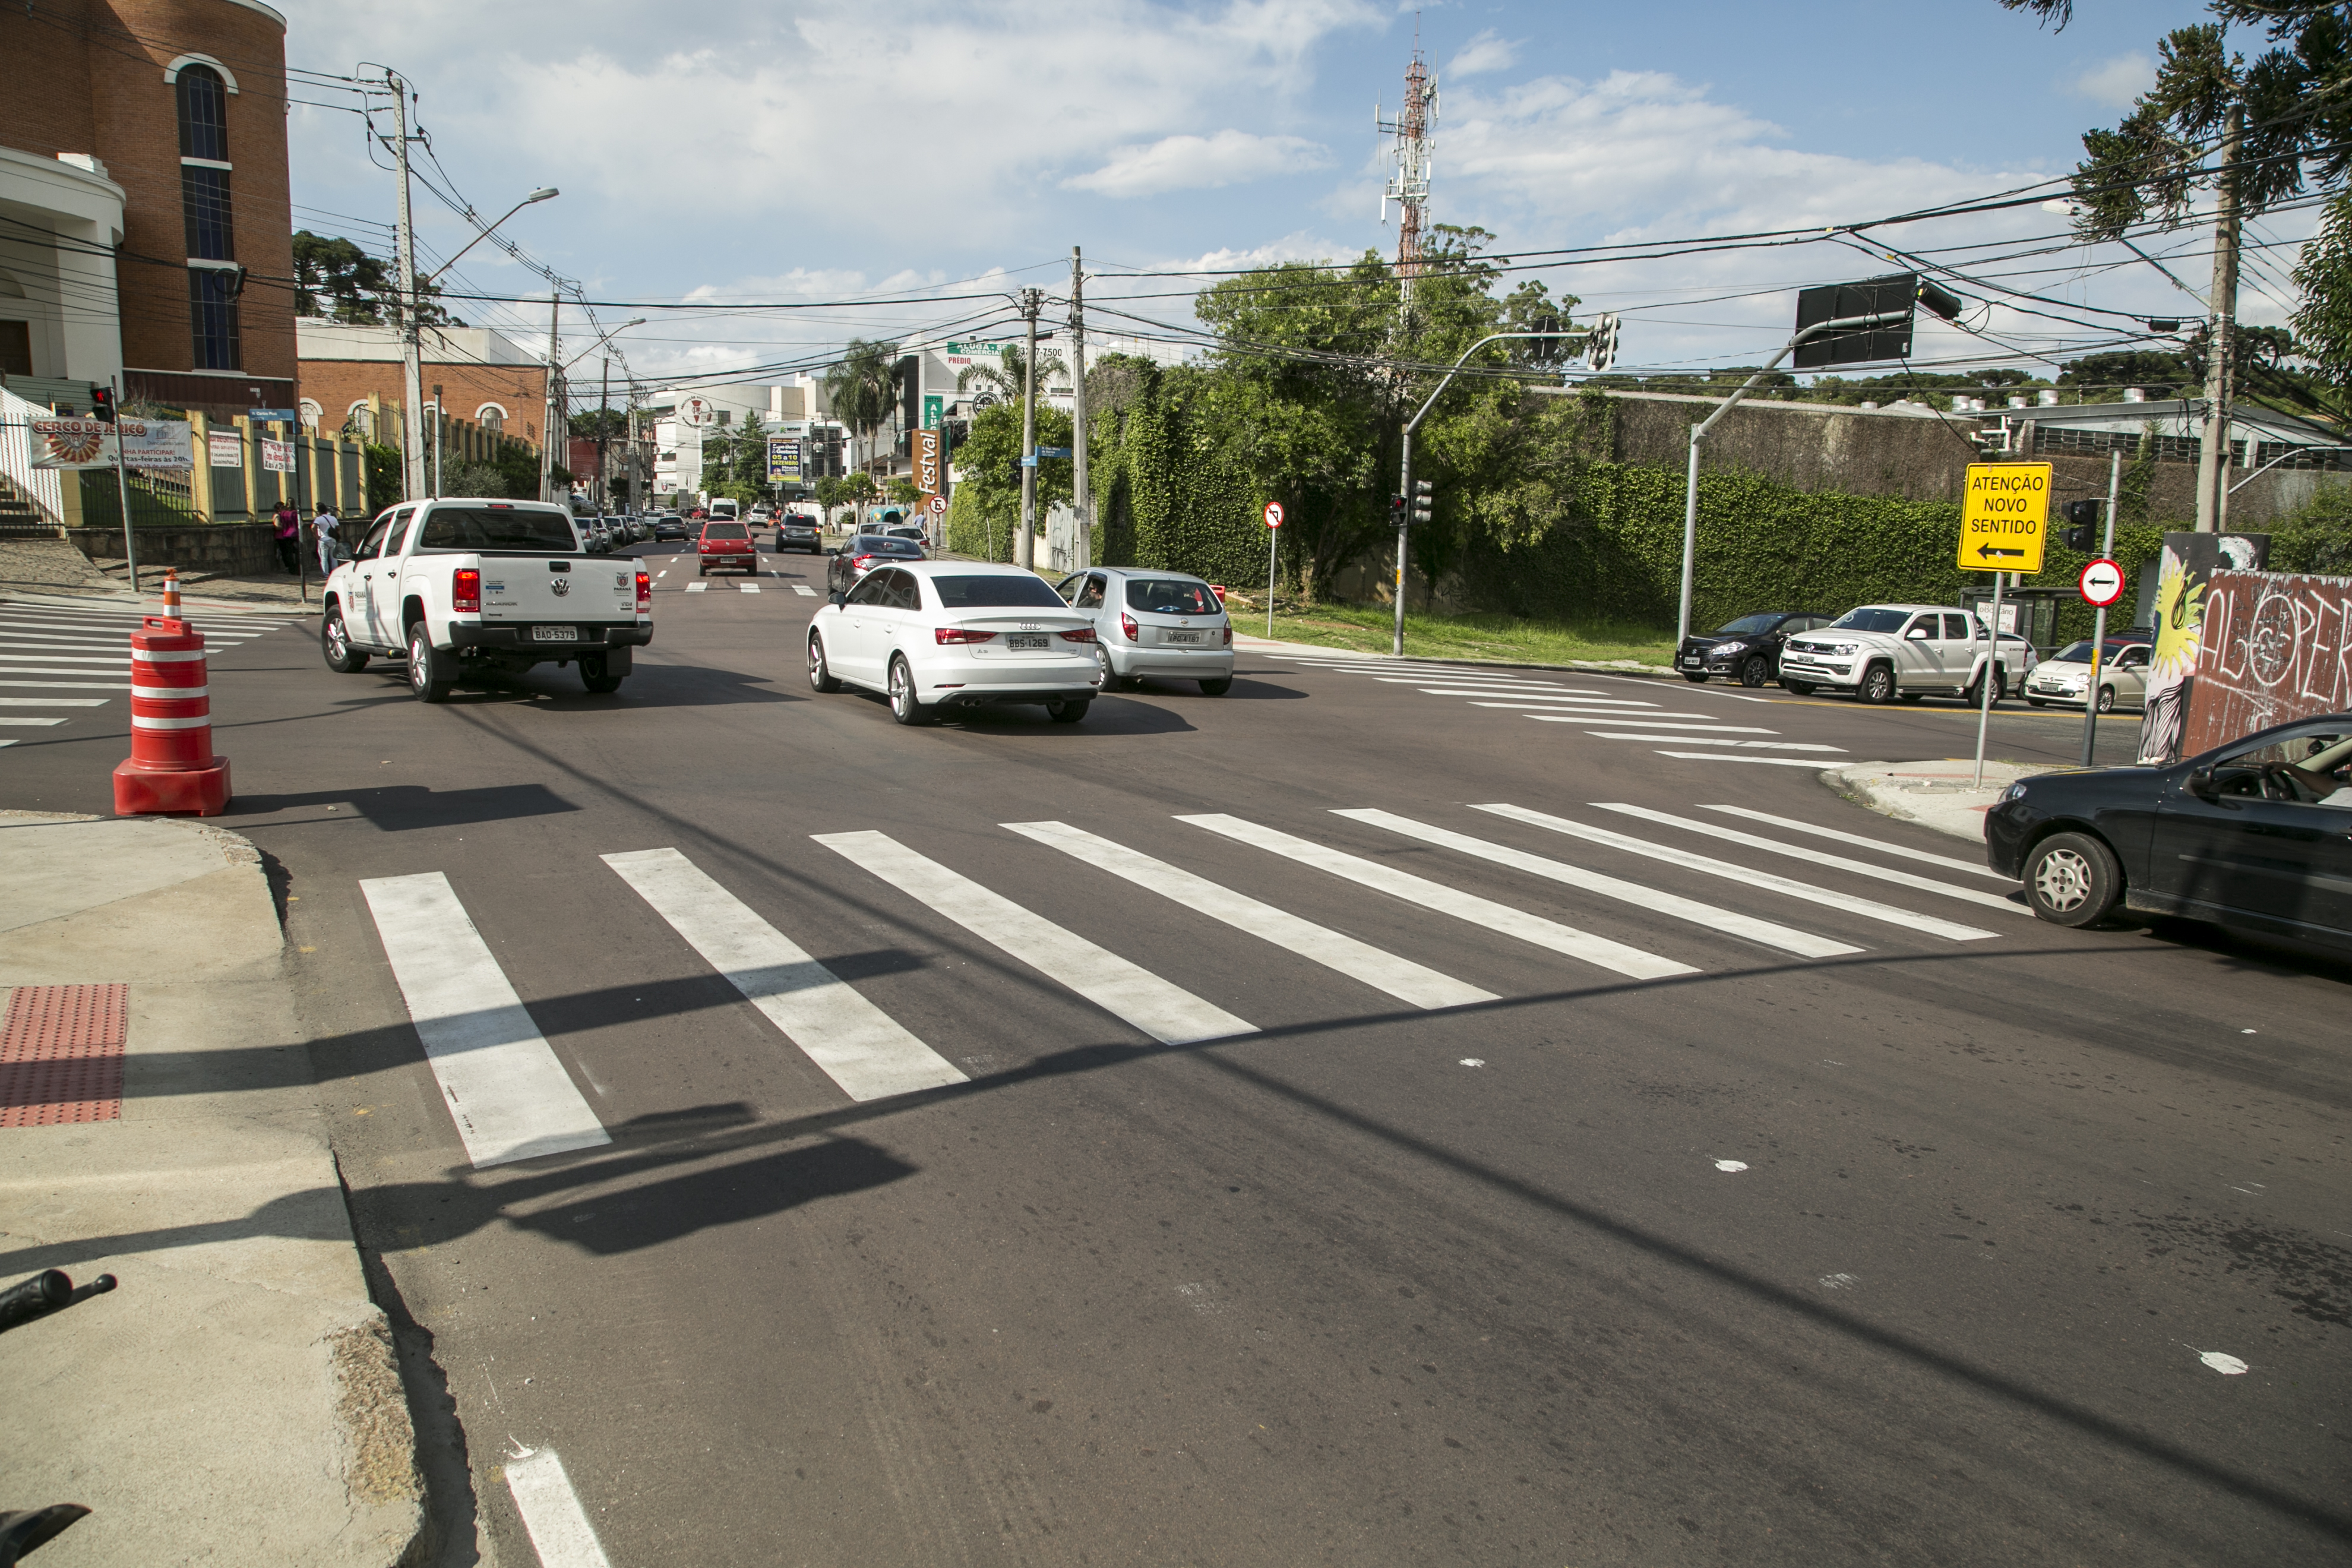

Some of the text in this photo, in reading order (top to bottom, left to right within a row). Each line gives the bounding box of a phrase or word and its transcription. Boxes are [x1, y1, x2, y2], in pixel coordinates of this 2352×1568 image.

[1020, 347, 1062, 356] 37-7500
[33, 421, 83, 434] CERCO
[84, 422, 102, 434] DE
[919, 432, 937, 495] Festval
[1972, 473, 2043, 494] ATENÇÃO
[1984, 498, 2027, 512] NOVO
[1971, 519, 2036, 535] SENTIDO
[1009, 638, 1048, 647] BBS-1269
